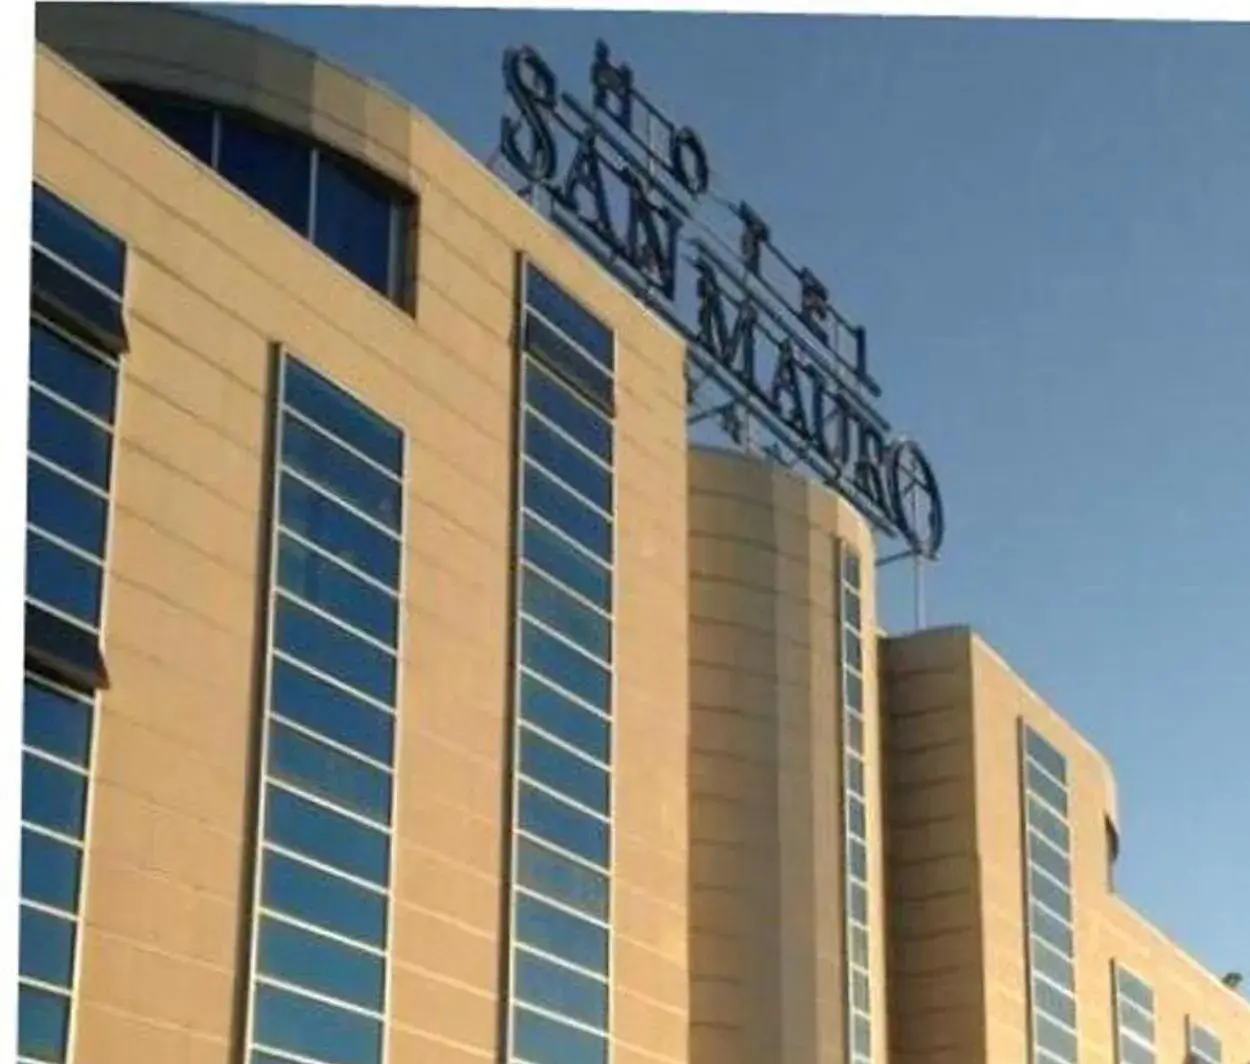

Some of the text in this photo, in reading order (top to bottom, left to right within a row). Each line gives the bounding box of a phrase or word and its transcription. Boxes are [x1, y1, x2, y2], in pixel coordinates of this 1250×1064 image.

[500, 44, 944, 560] SAN MAURO
[590, 38, 878, 392] HOTEL
